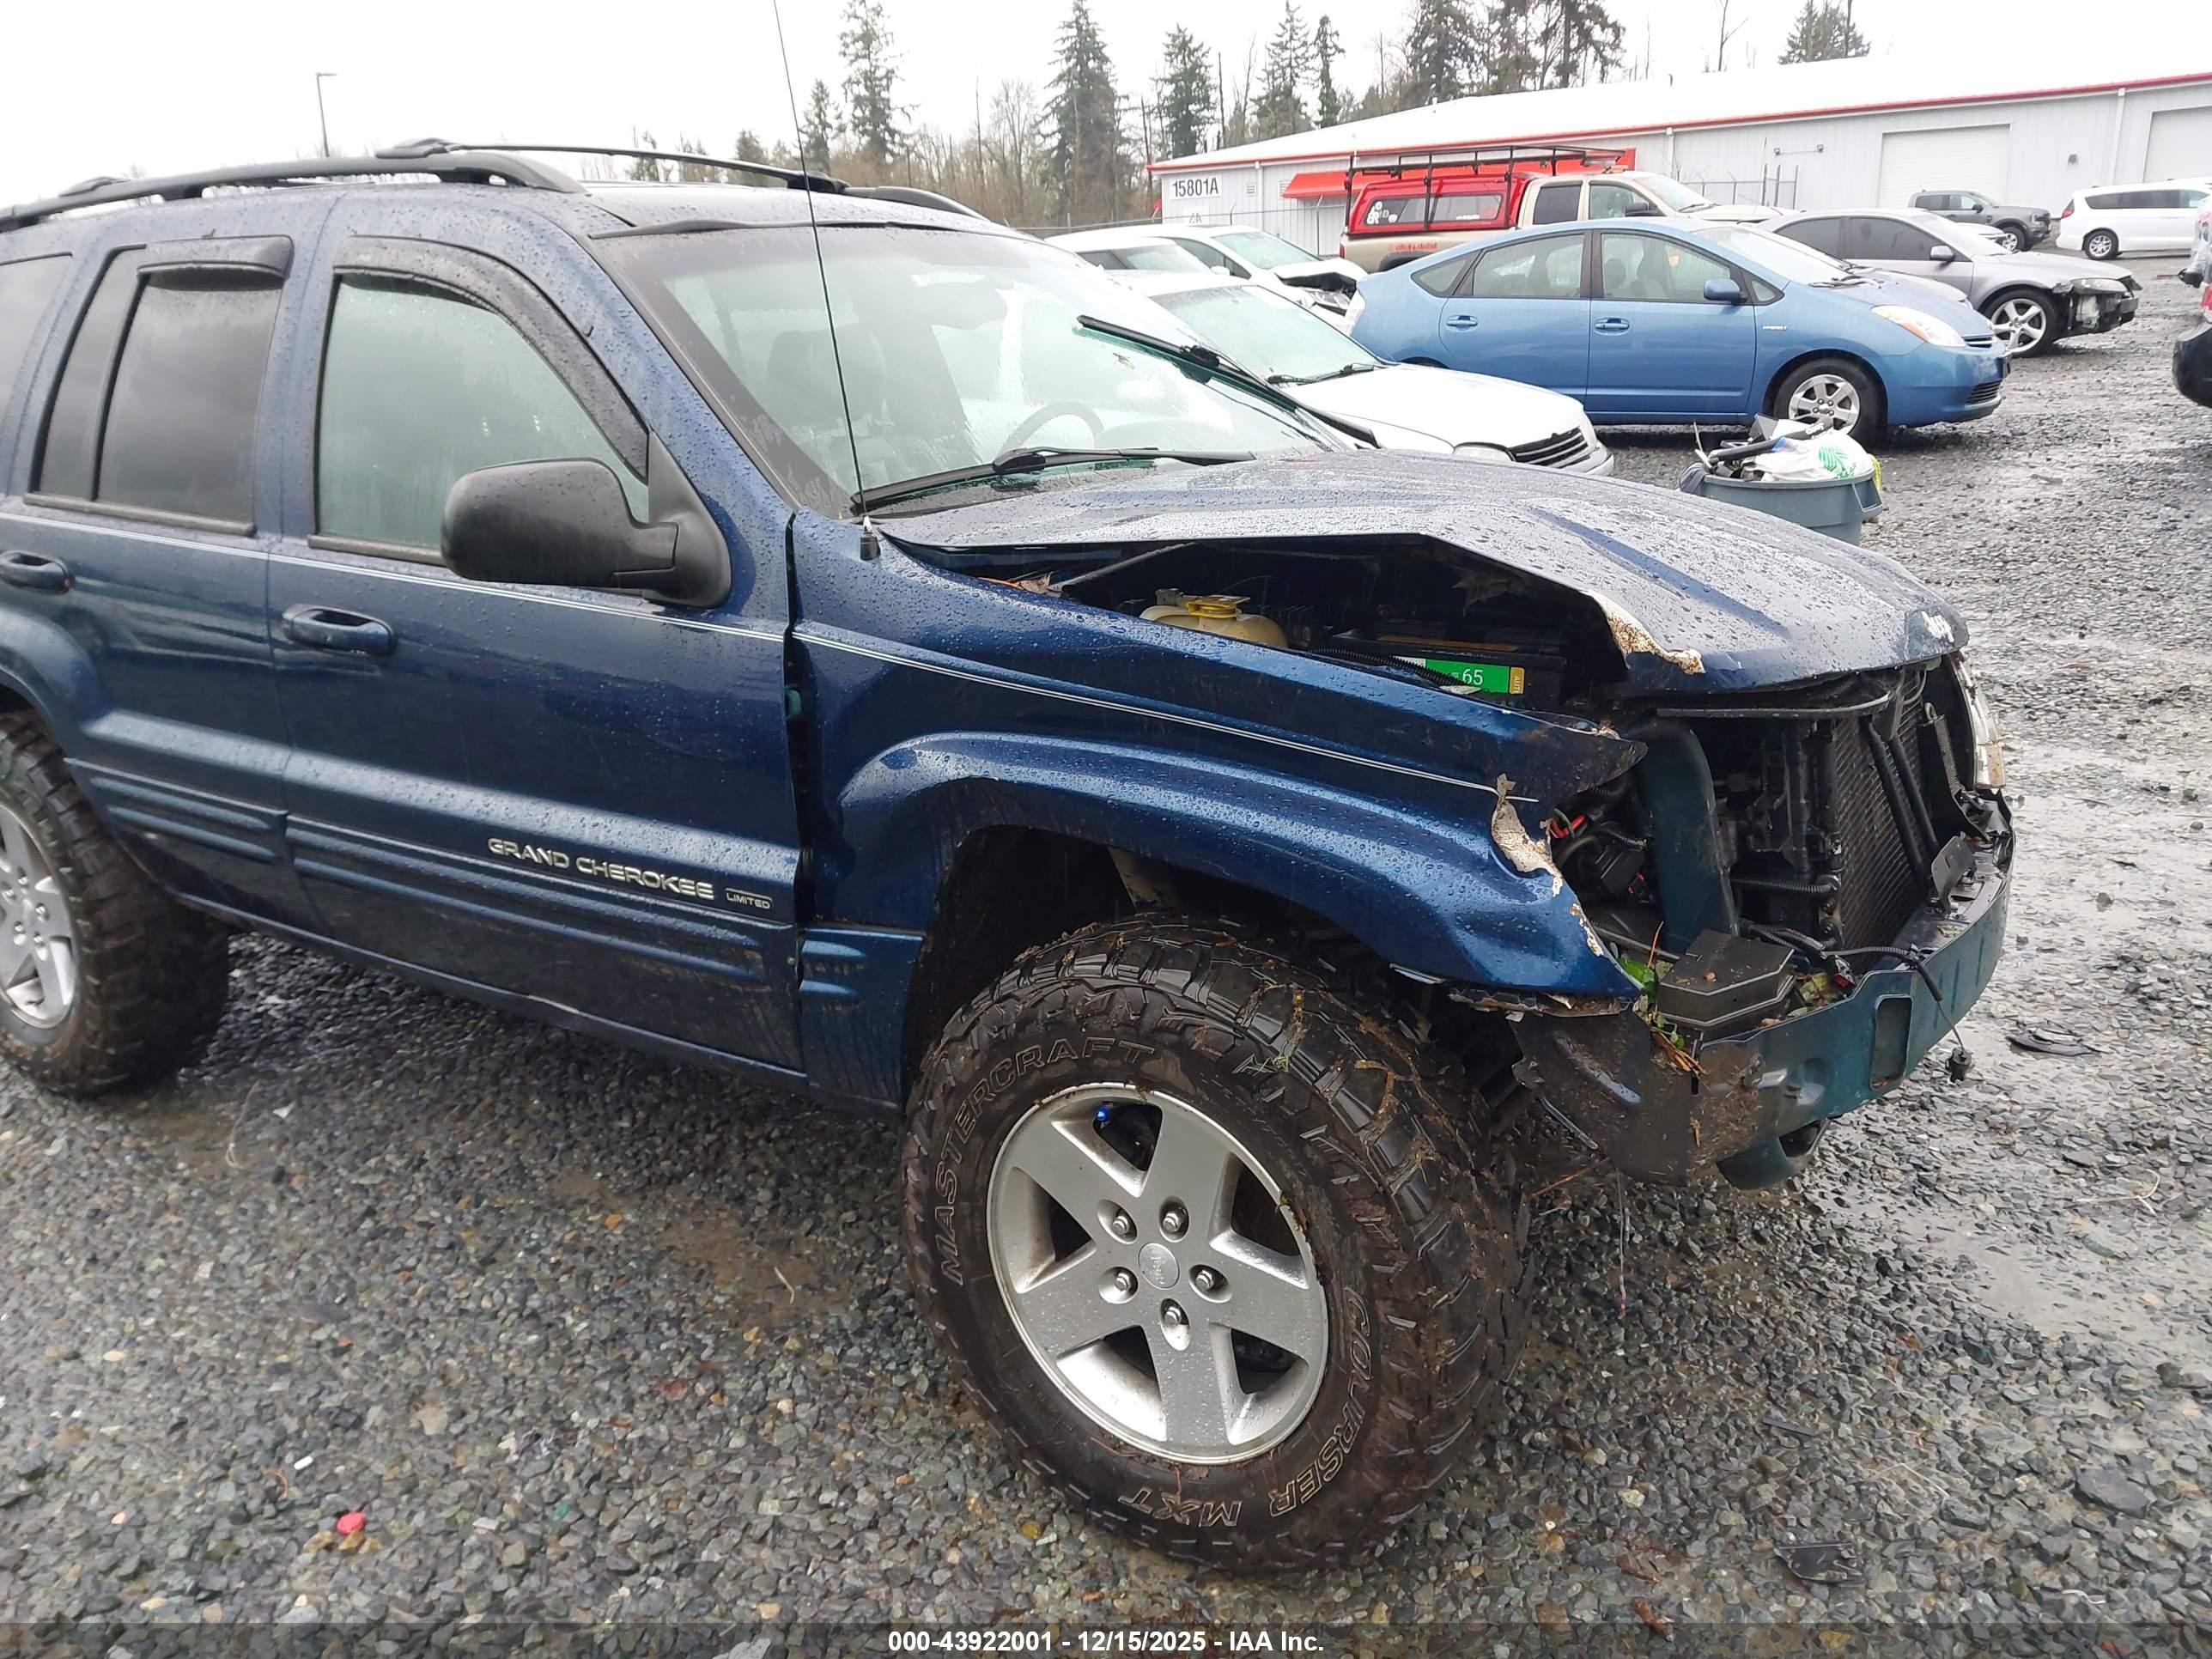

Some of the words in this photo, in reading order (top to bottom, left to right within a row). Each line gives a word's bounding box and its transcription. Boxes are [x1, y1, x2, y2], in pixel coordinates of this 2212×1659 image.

[1172, 177, 1218, 198] 15801A
[1462, 668, 1484, 685] 65
[487, 837, 570, 869] GRAND
[575, 857, 714, 900] CHEROKEE
[726, 892, 771, 910] LIMITED
[934, 1036, 1156, 1286] MASTERCRAFT
[1267, 1286, 1374, 1518] COURSER
[1117, 1486, 1243, 1528] MXT
